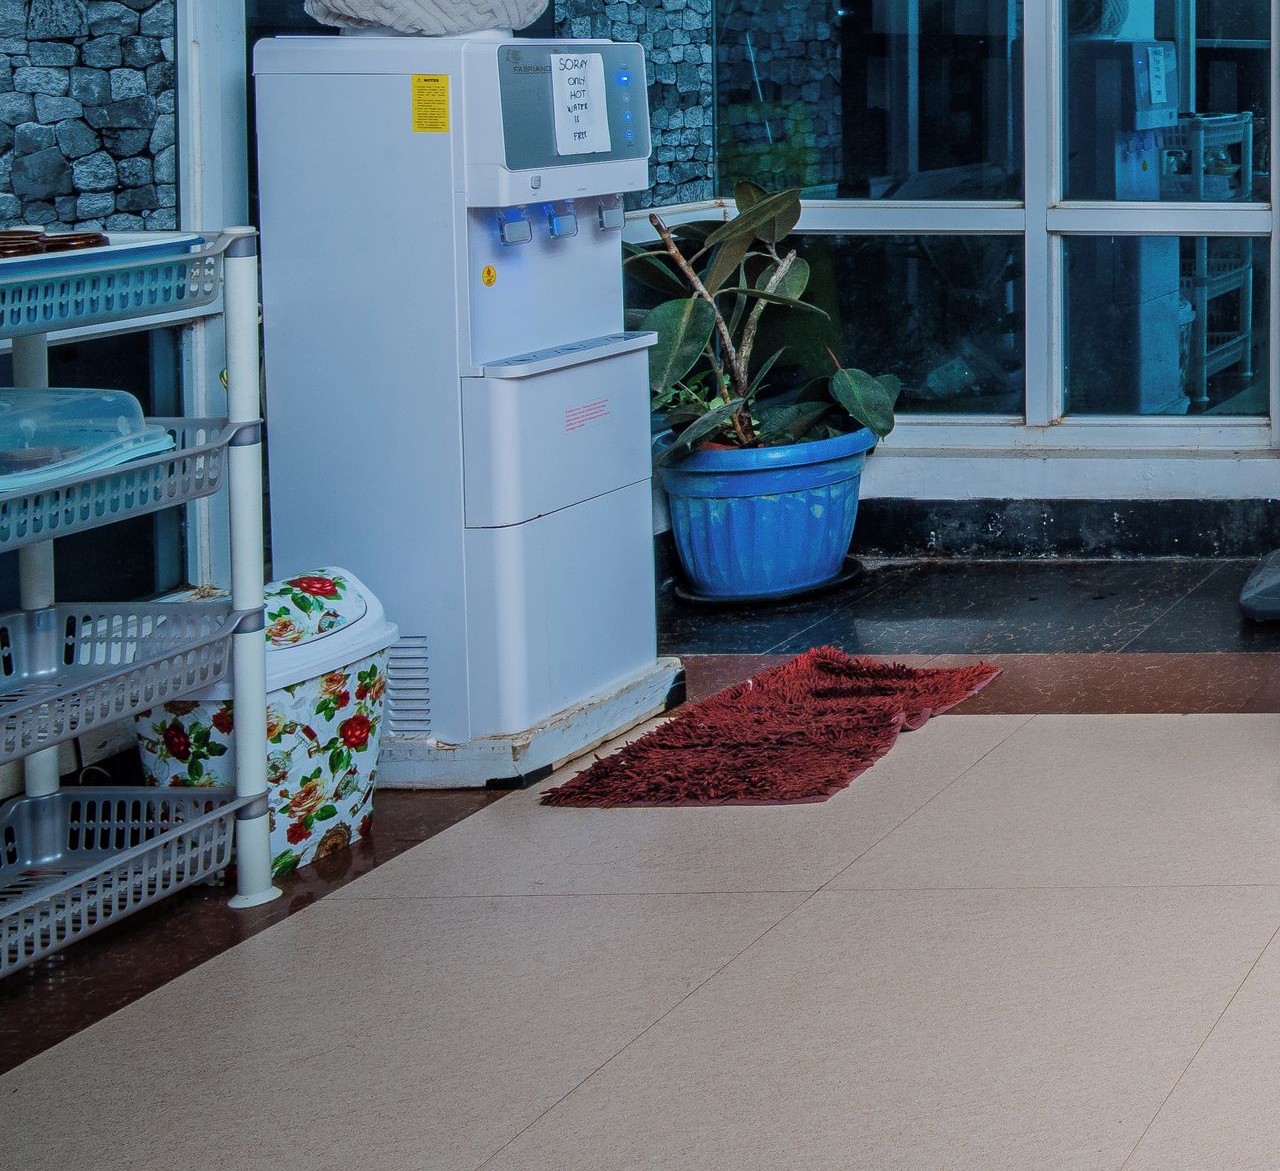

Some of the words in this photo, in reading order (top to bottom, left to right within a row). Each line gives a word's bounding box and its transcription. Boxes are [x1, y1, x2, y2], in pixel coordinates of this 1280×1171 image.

[560, 58, 588, 71] SORRY
[570, 90, 586, 100] HOT
[567, 103, 588, 113] WATER
[573, 131, 587, 141] FREE
